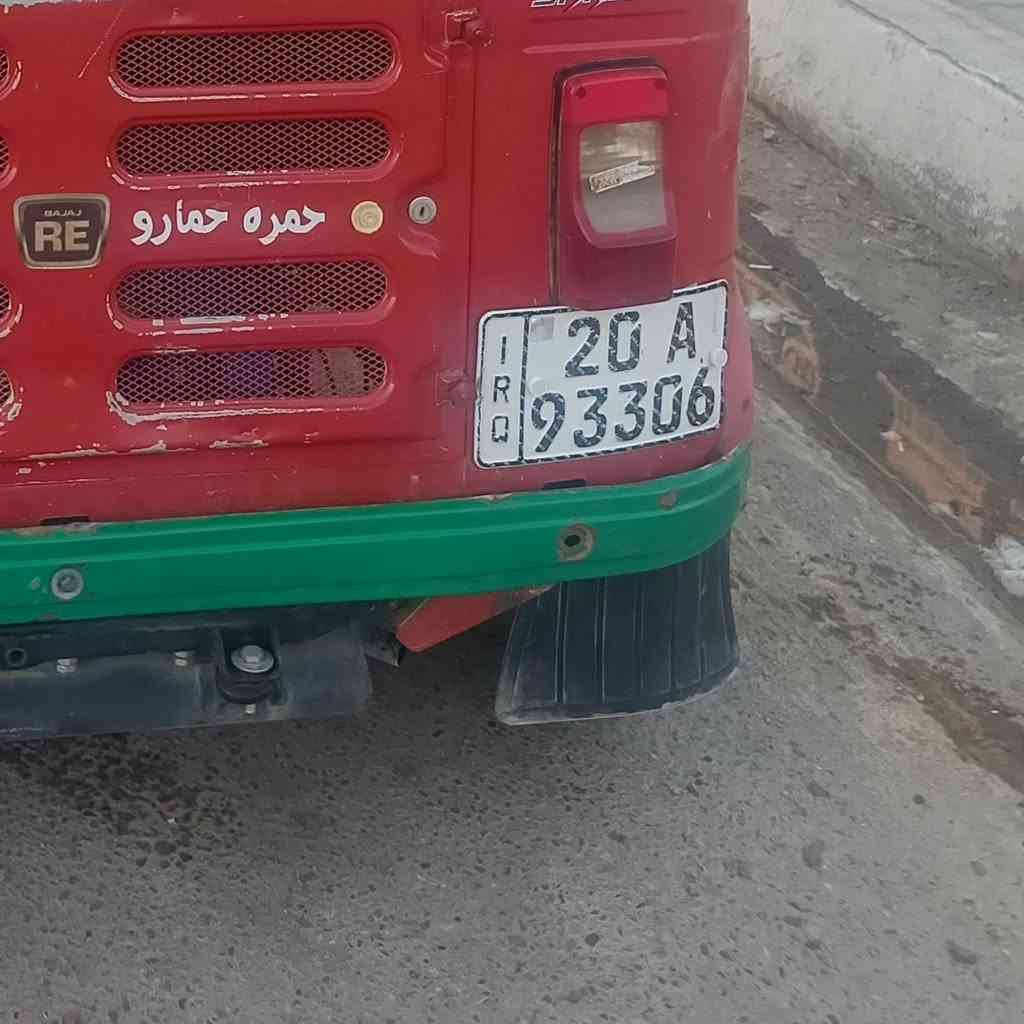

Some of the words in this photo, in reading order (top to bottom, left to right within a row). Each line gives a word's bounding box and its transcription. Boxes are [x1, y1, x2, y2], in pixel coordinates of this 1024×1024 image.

[43, 208, 83, 217] BAJAJ
[243, 205, 326, 246] حمره
[34, 219, 90, 252] RE
[564, 310, 643, 378] 20
[666, 301, 697, 364] A
[531, 366, 716, 453] 93306
